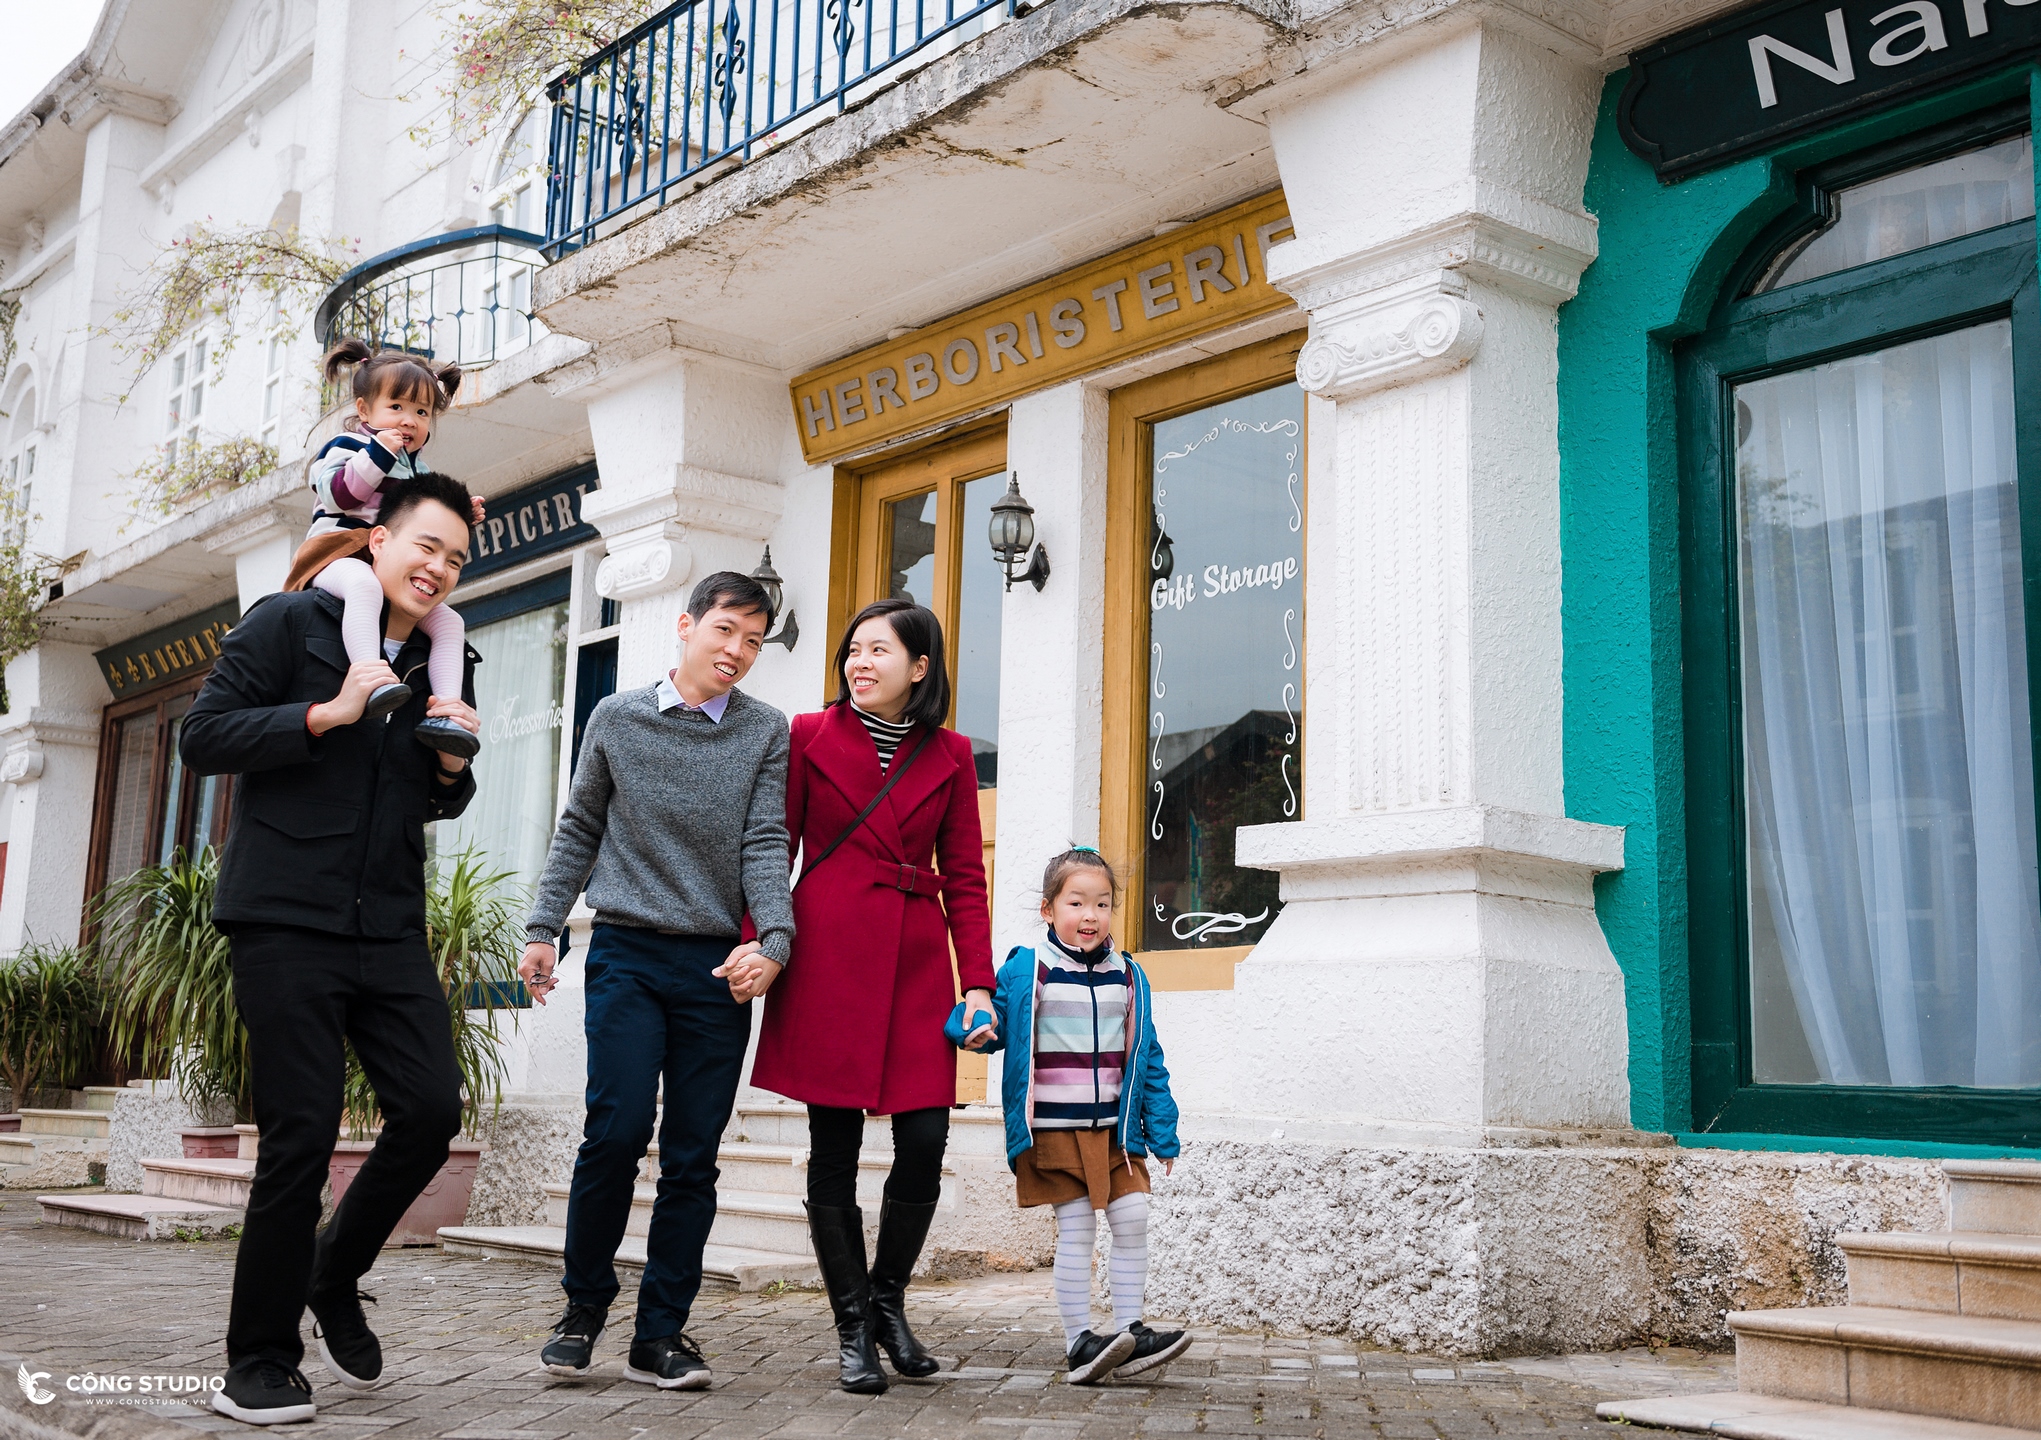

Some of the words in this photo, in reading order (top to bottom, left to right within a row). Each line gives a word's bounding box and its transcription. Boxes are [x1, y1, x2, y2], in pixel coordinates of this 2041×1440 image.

[1748, 0, 2039, 109] Nar
[1151, 574, 1197, 610] Gift
[1203, 557, 1298, 598] Storage
[138, 621, 232, 680] EUGENE'
